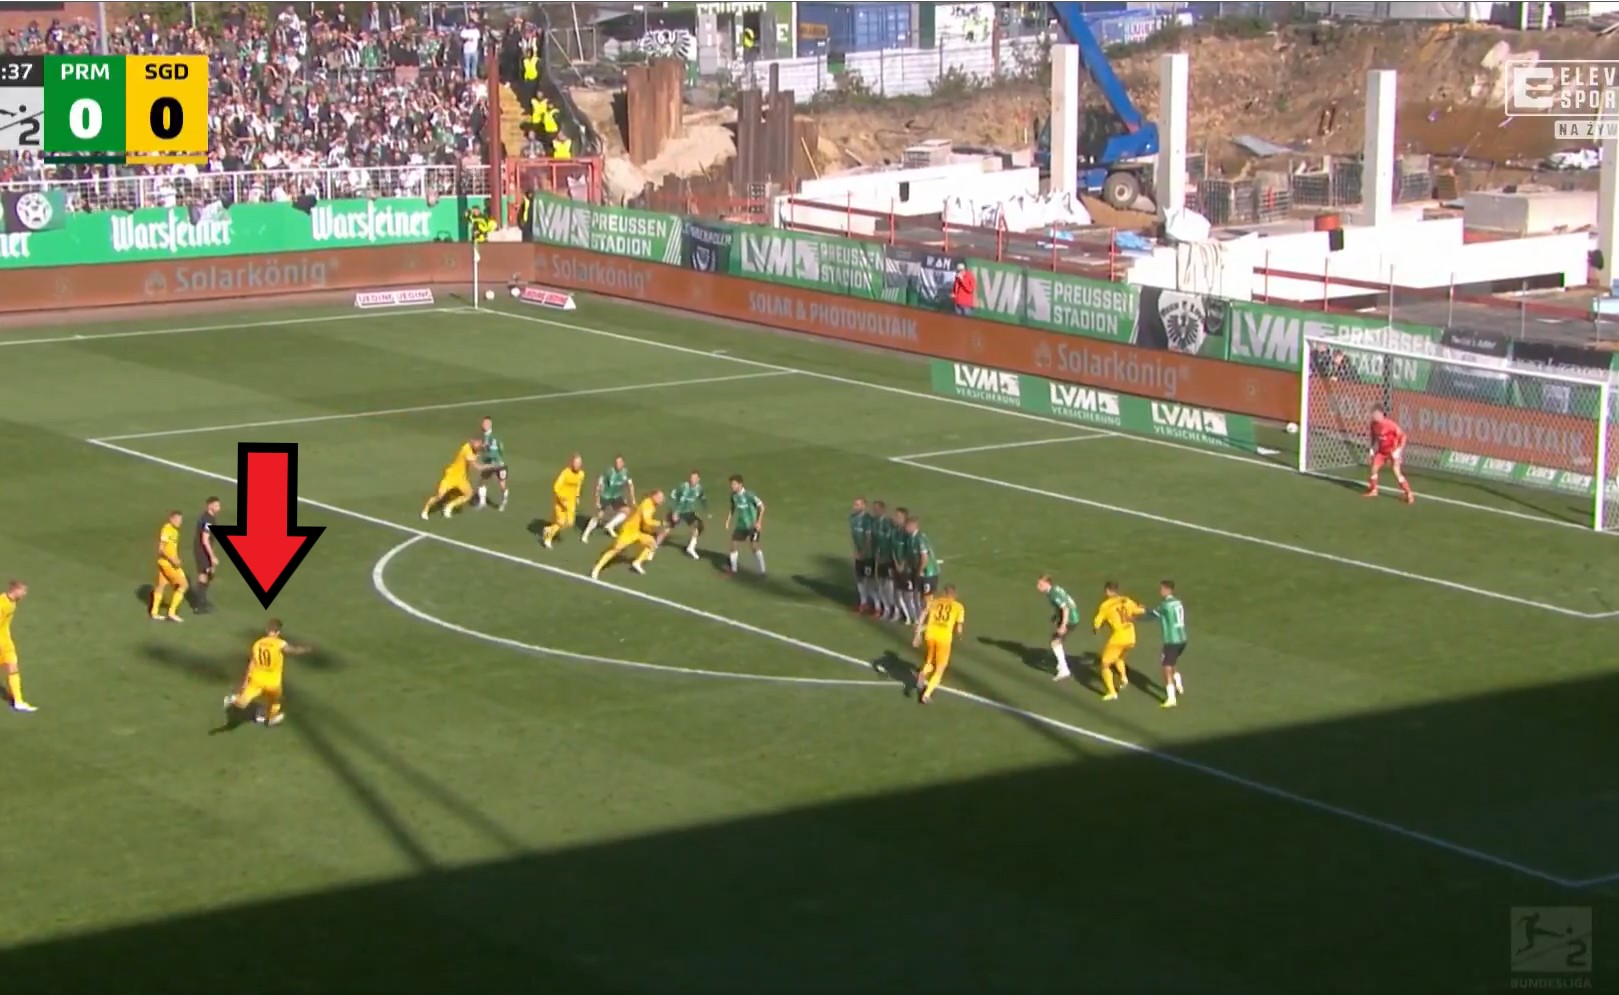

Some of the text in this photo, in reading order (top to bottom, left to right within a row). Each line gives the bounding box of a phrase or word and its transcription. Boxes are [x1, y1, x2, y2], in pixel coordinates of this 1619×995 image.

[111, 208, 232, 253] Warsteiner
[311, 205, 432, 242] Warsteiner
[533, 198, 570, 243] LVM
[591, 211, 667, 238] PREUSSEN
[591, 233, 651, 257] STADION
[741, 231, 793, 279] LVM
[175, 257, 329, 292] Solarkönig
[552, 253, 646, 294] Solarkönig
[749, 290, 919, 340] SOLAR & PHOTOVOLTAIK
[1053, 281, 1134, 316] PREUSSEN
[1053, 305, 1118, 335] STADION
[1231, 310, 1299, 363] LVM
[953, 362, 999, 393] LVM
[1057, 343, 1178, 397] Solarkönig
[955, 387, 1021, 407] VERSICHERUNG
[1049, 382, 1096, 413] LVM
[1051, 404, 1121, 426] VERSICHERUNG
[1151, 400, 1203, 432] LVM
[934, 603, 952, 621] 33
